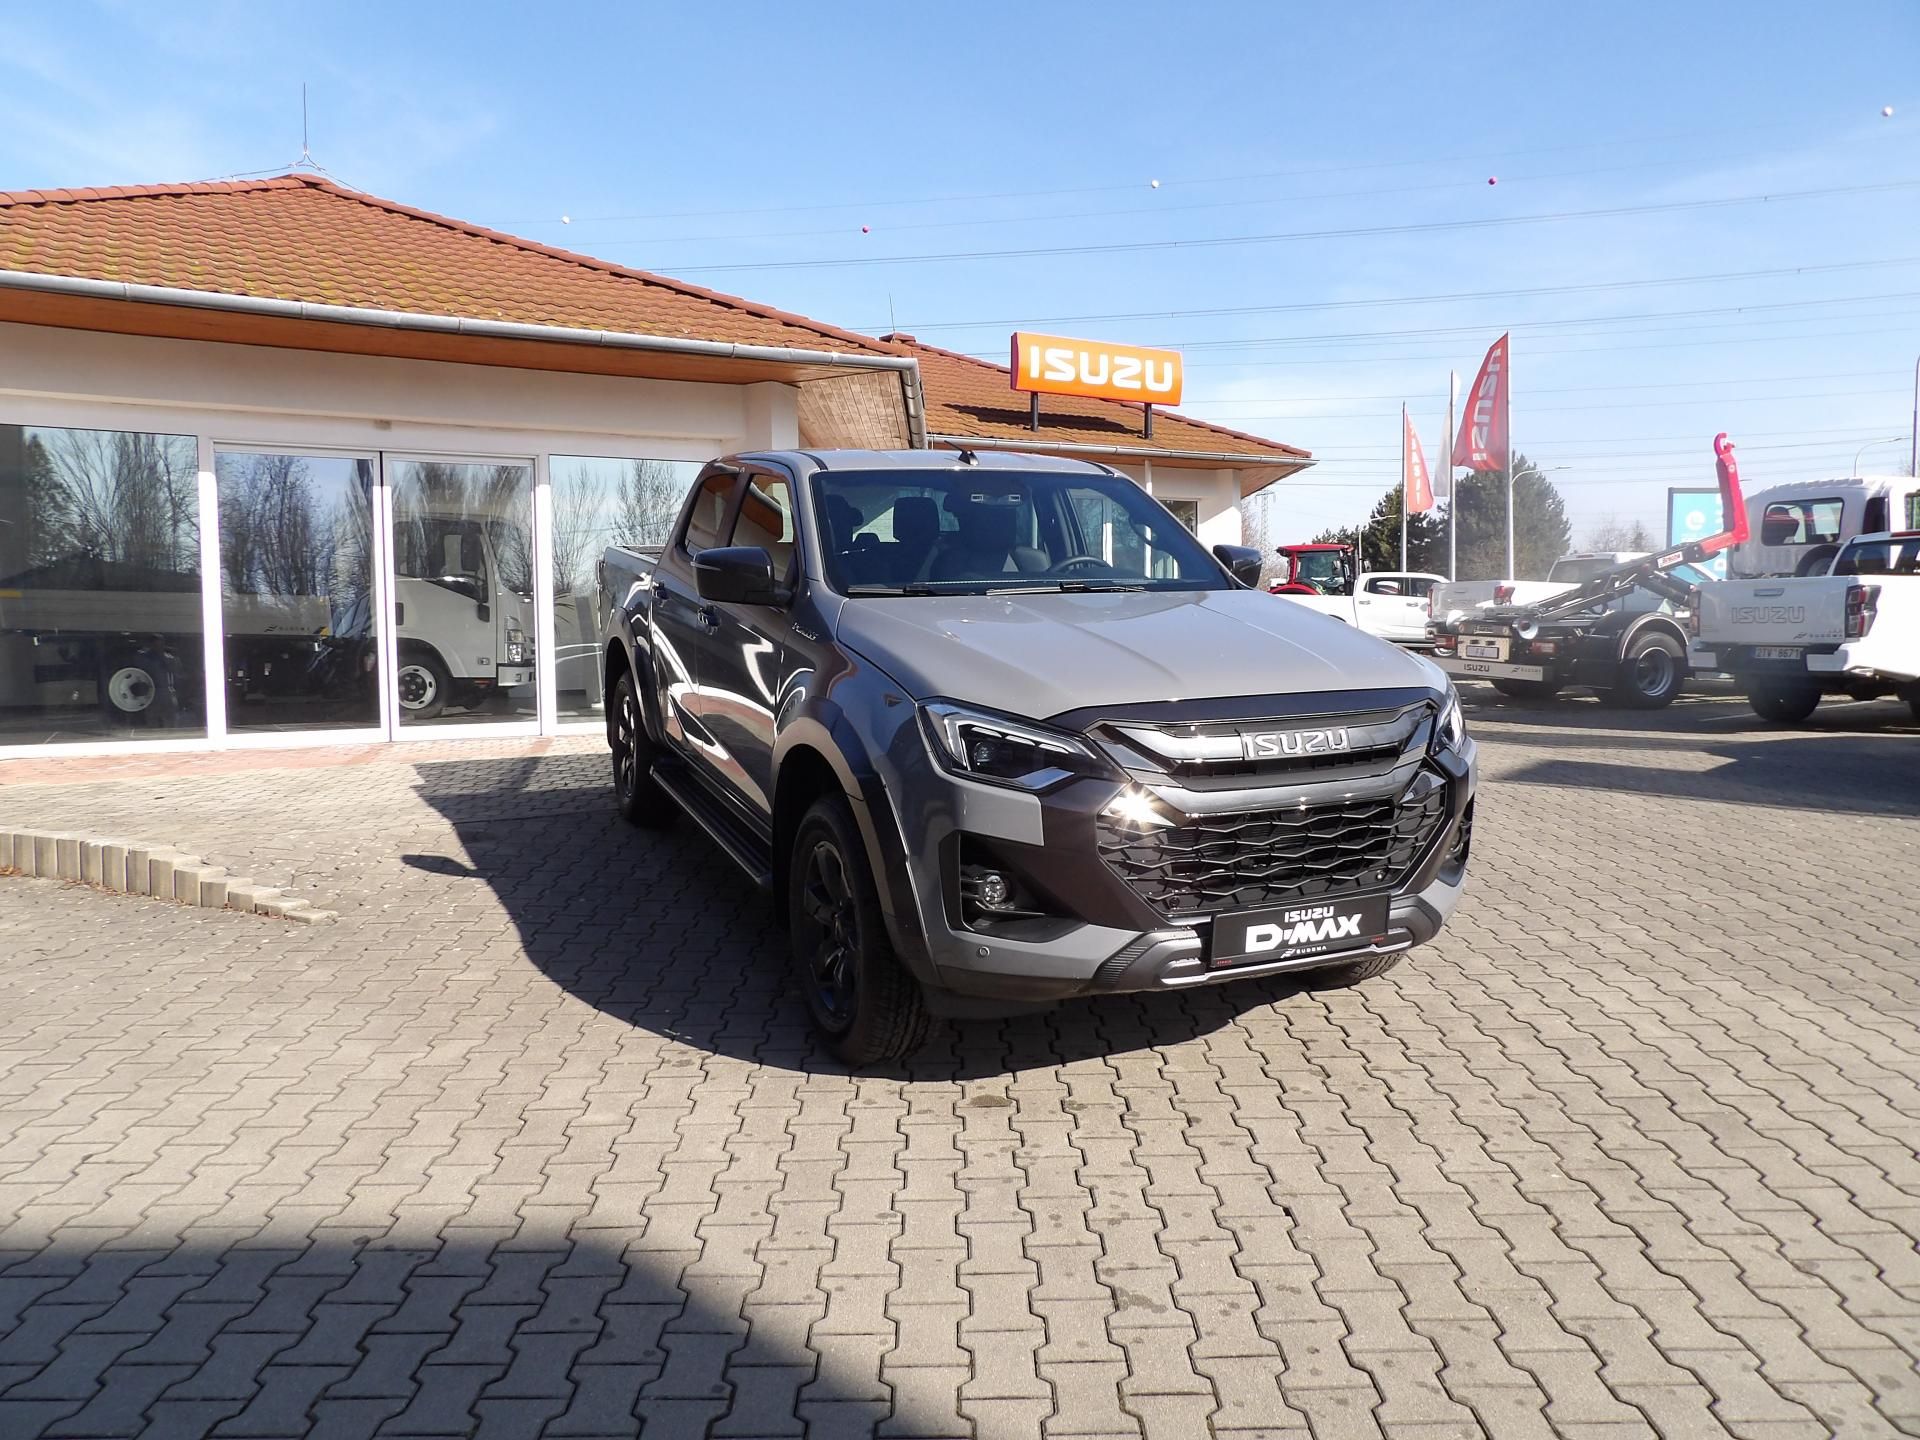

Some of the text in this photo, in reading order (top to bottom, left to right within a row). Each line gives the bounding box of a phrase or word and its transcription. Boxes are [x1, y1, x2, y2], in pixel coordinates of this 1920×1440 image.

[1029, 345, 1174, 392] ISUZU
[1731, 606, 1805, 624] ISUZU
[1463, 663, 1490, 672] ISUZU
[1243, 728, 1348, 758] ISUZU
[1284, 905, 1334, 923] ISUZU
[1245, 913, 1362, 953] D-MAX
